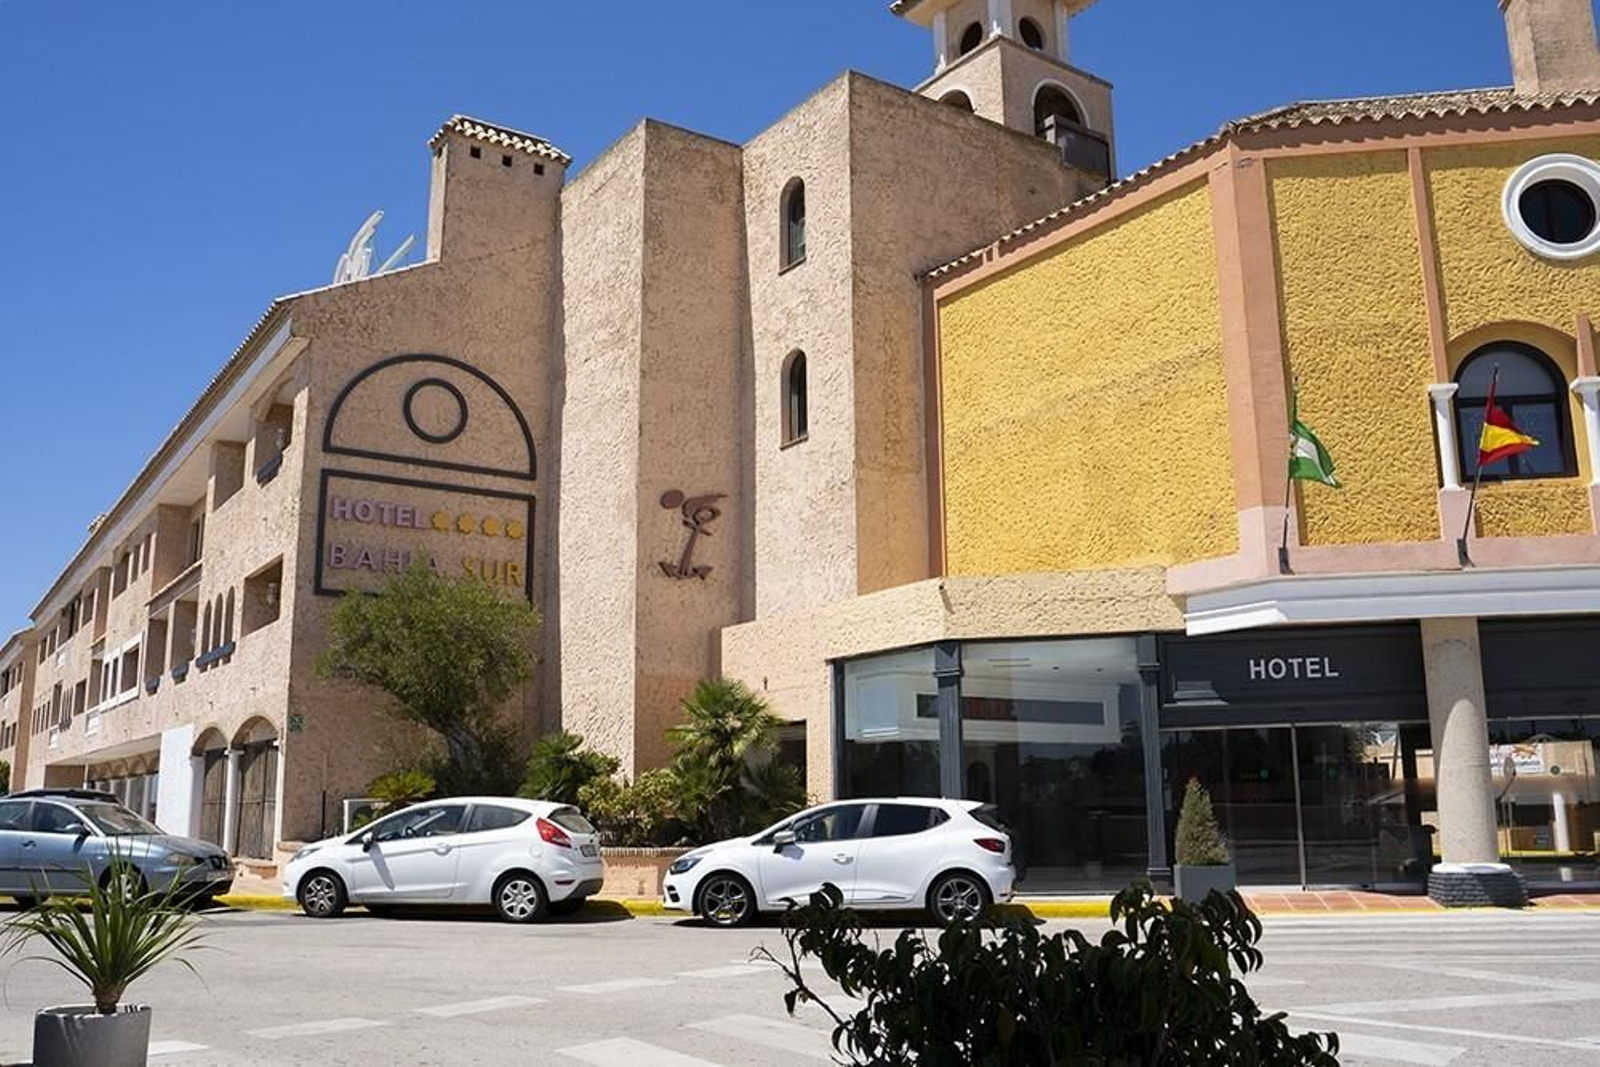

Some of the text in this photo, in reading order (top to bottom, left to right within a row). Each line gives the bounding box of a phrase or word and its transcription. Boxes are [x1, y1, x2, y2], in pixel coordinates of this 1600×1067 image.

[332, 498, 427, 529] HOTEL
[461, 556, 522, 587] SUR
[1249, 657, 1339, 679] HOTEL
